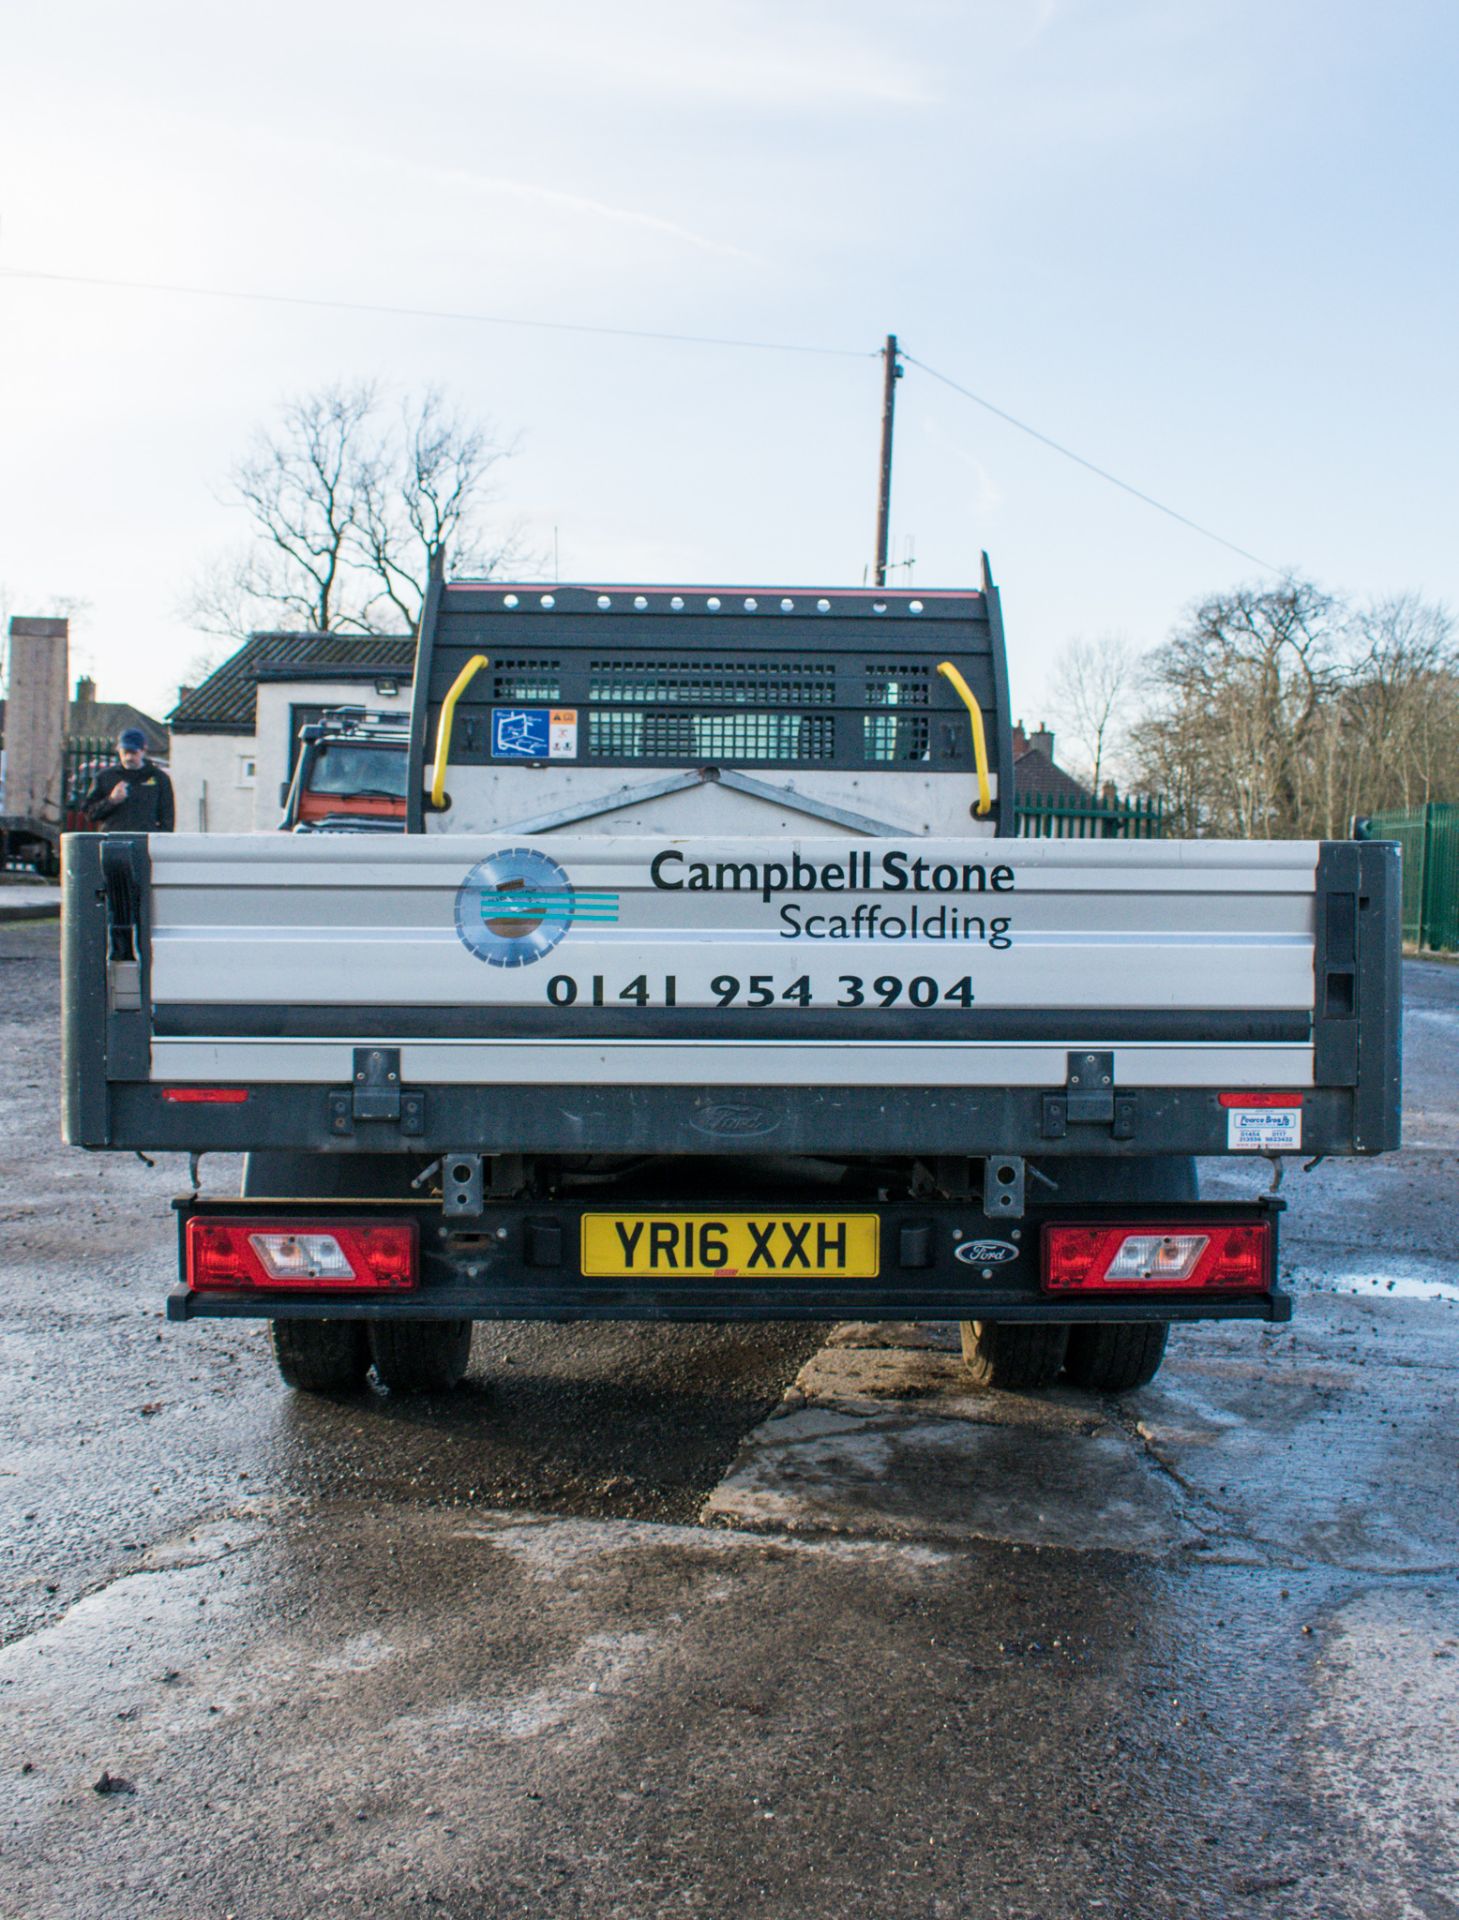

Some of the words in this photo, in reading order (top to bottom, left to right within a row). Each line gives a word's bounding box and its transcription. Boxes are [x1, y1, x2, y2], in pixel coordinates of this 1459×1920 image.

[650, 851, 871, 903] Campbell
[882, 851, 1016, 893] Stone
[779, 904, 1012, 950] Scaffolding
[546, 975, 677, 1008] 0141
[710, 976, 813, 1008] 954
[836, 976, 975, 1009] 3904
[615, 1222, 729, 1268] YR16
[747, 1222, 846, 1268] XXH
[969, 1244, 1006, 1261] Ford
